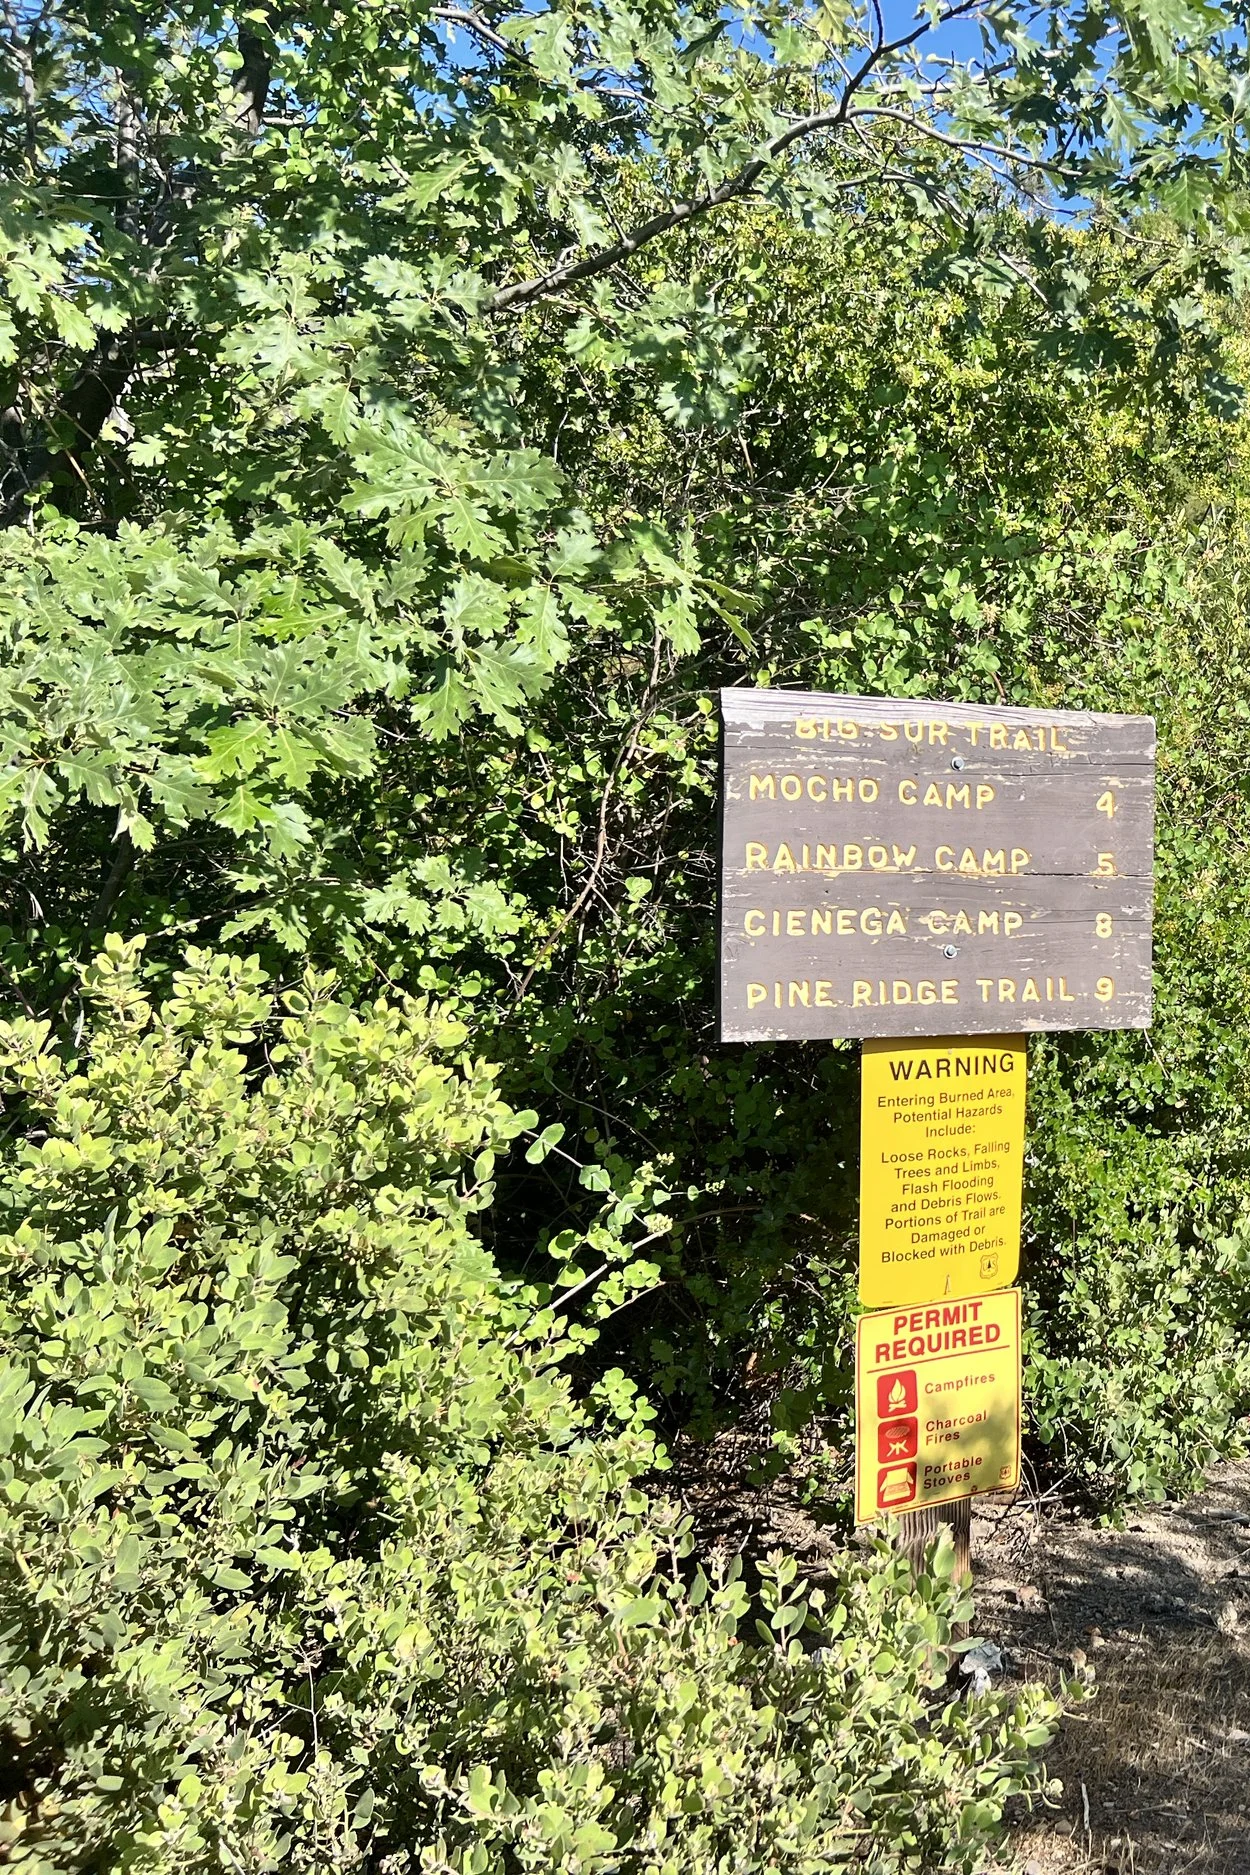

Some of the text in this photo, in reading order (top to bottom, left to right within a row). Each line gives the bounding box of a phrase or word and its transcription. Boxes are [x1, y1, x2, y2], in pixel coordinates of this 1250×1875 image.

[794, 718, 1068, 752] BIG SUR TRAIL
[749, 774, 1115, 818] MOCHO CAMP 4
[744, 842, 1115, 875] RAINBOW CAMP 5
[743, 906, 1113, 938] CIENEGA CAMP 8
[746, 977, 1115, 1009] PINE RIDGE TRAIL 9
[889, 1053, 1015, 1081] WARNING
[878, 1094, 935, 1108] Entering
[940, 1091, 983, 1103] Burned
[894, 1105, 1002, 1123] Potential Hazards
[925, 1125, 975, 1138] Include:
[881, 1141, 1010, 1163] Loose Rocks, Falling
[894, 1166, 931, 1179] Trees
[935, 1162, 958, 1176] and
[902, 1176, 994, 1195] Flash Flooding
[891, 1200, 916, 1213] and
[921, 1195, 962, 1210] Debris
[885, 1206, 1005, 1229] Portions of Trail are
[911, 1226, 986, 1244] Damaged or
[881, 1238, 1007, 1263] Blocked with Debris.
[893, 1302, 983, 1335] PERMIT
[875, 1324, 1001, 1363] REQUIRED
[924, 1372, 996, 1394] Campfires
[926, 1410, 987, 1432] Charcoal
[926, 1430, 960, 1446] Fires
[924, 1456, 983, 1476] Portable
[924, 1472, 970, 1490] Stoves
